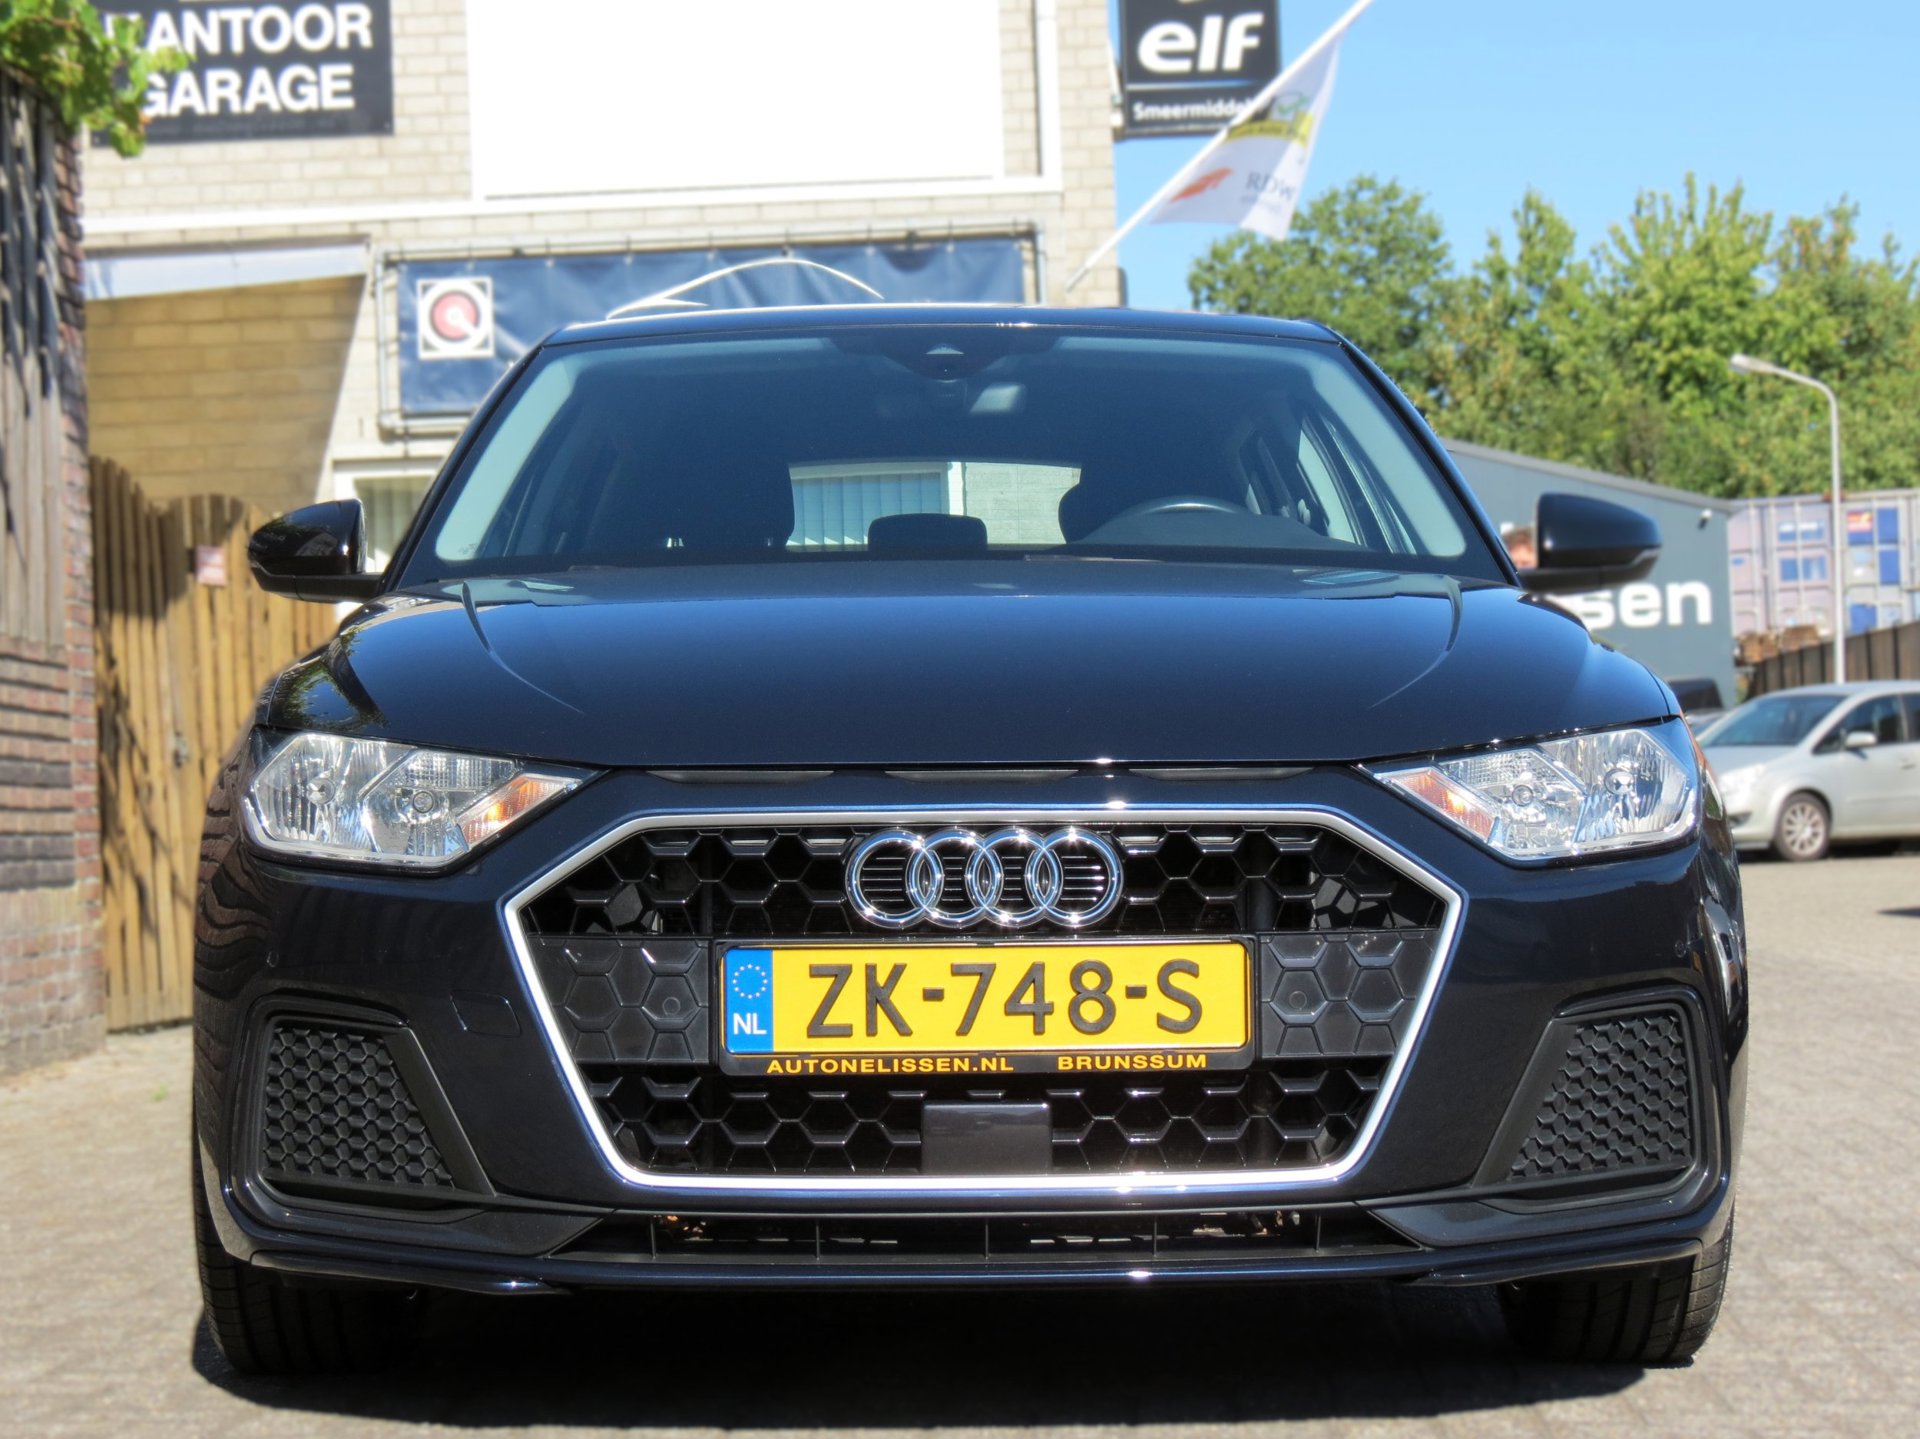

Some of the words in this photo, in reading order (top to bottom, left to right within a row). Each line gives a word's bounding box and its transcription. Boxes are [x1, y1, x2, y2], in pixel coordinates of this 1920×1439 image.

[1137, 11, 1264, 73] elf
[806, 959, 1204, 1038] ZK-748-S
[733, 1012, 767, 1035] NL
[766, 1056, 1014, 1074] AUTONELISSEN.NL
[1057, 1053, 1207, 1071] BRUNSSUM
